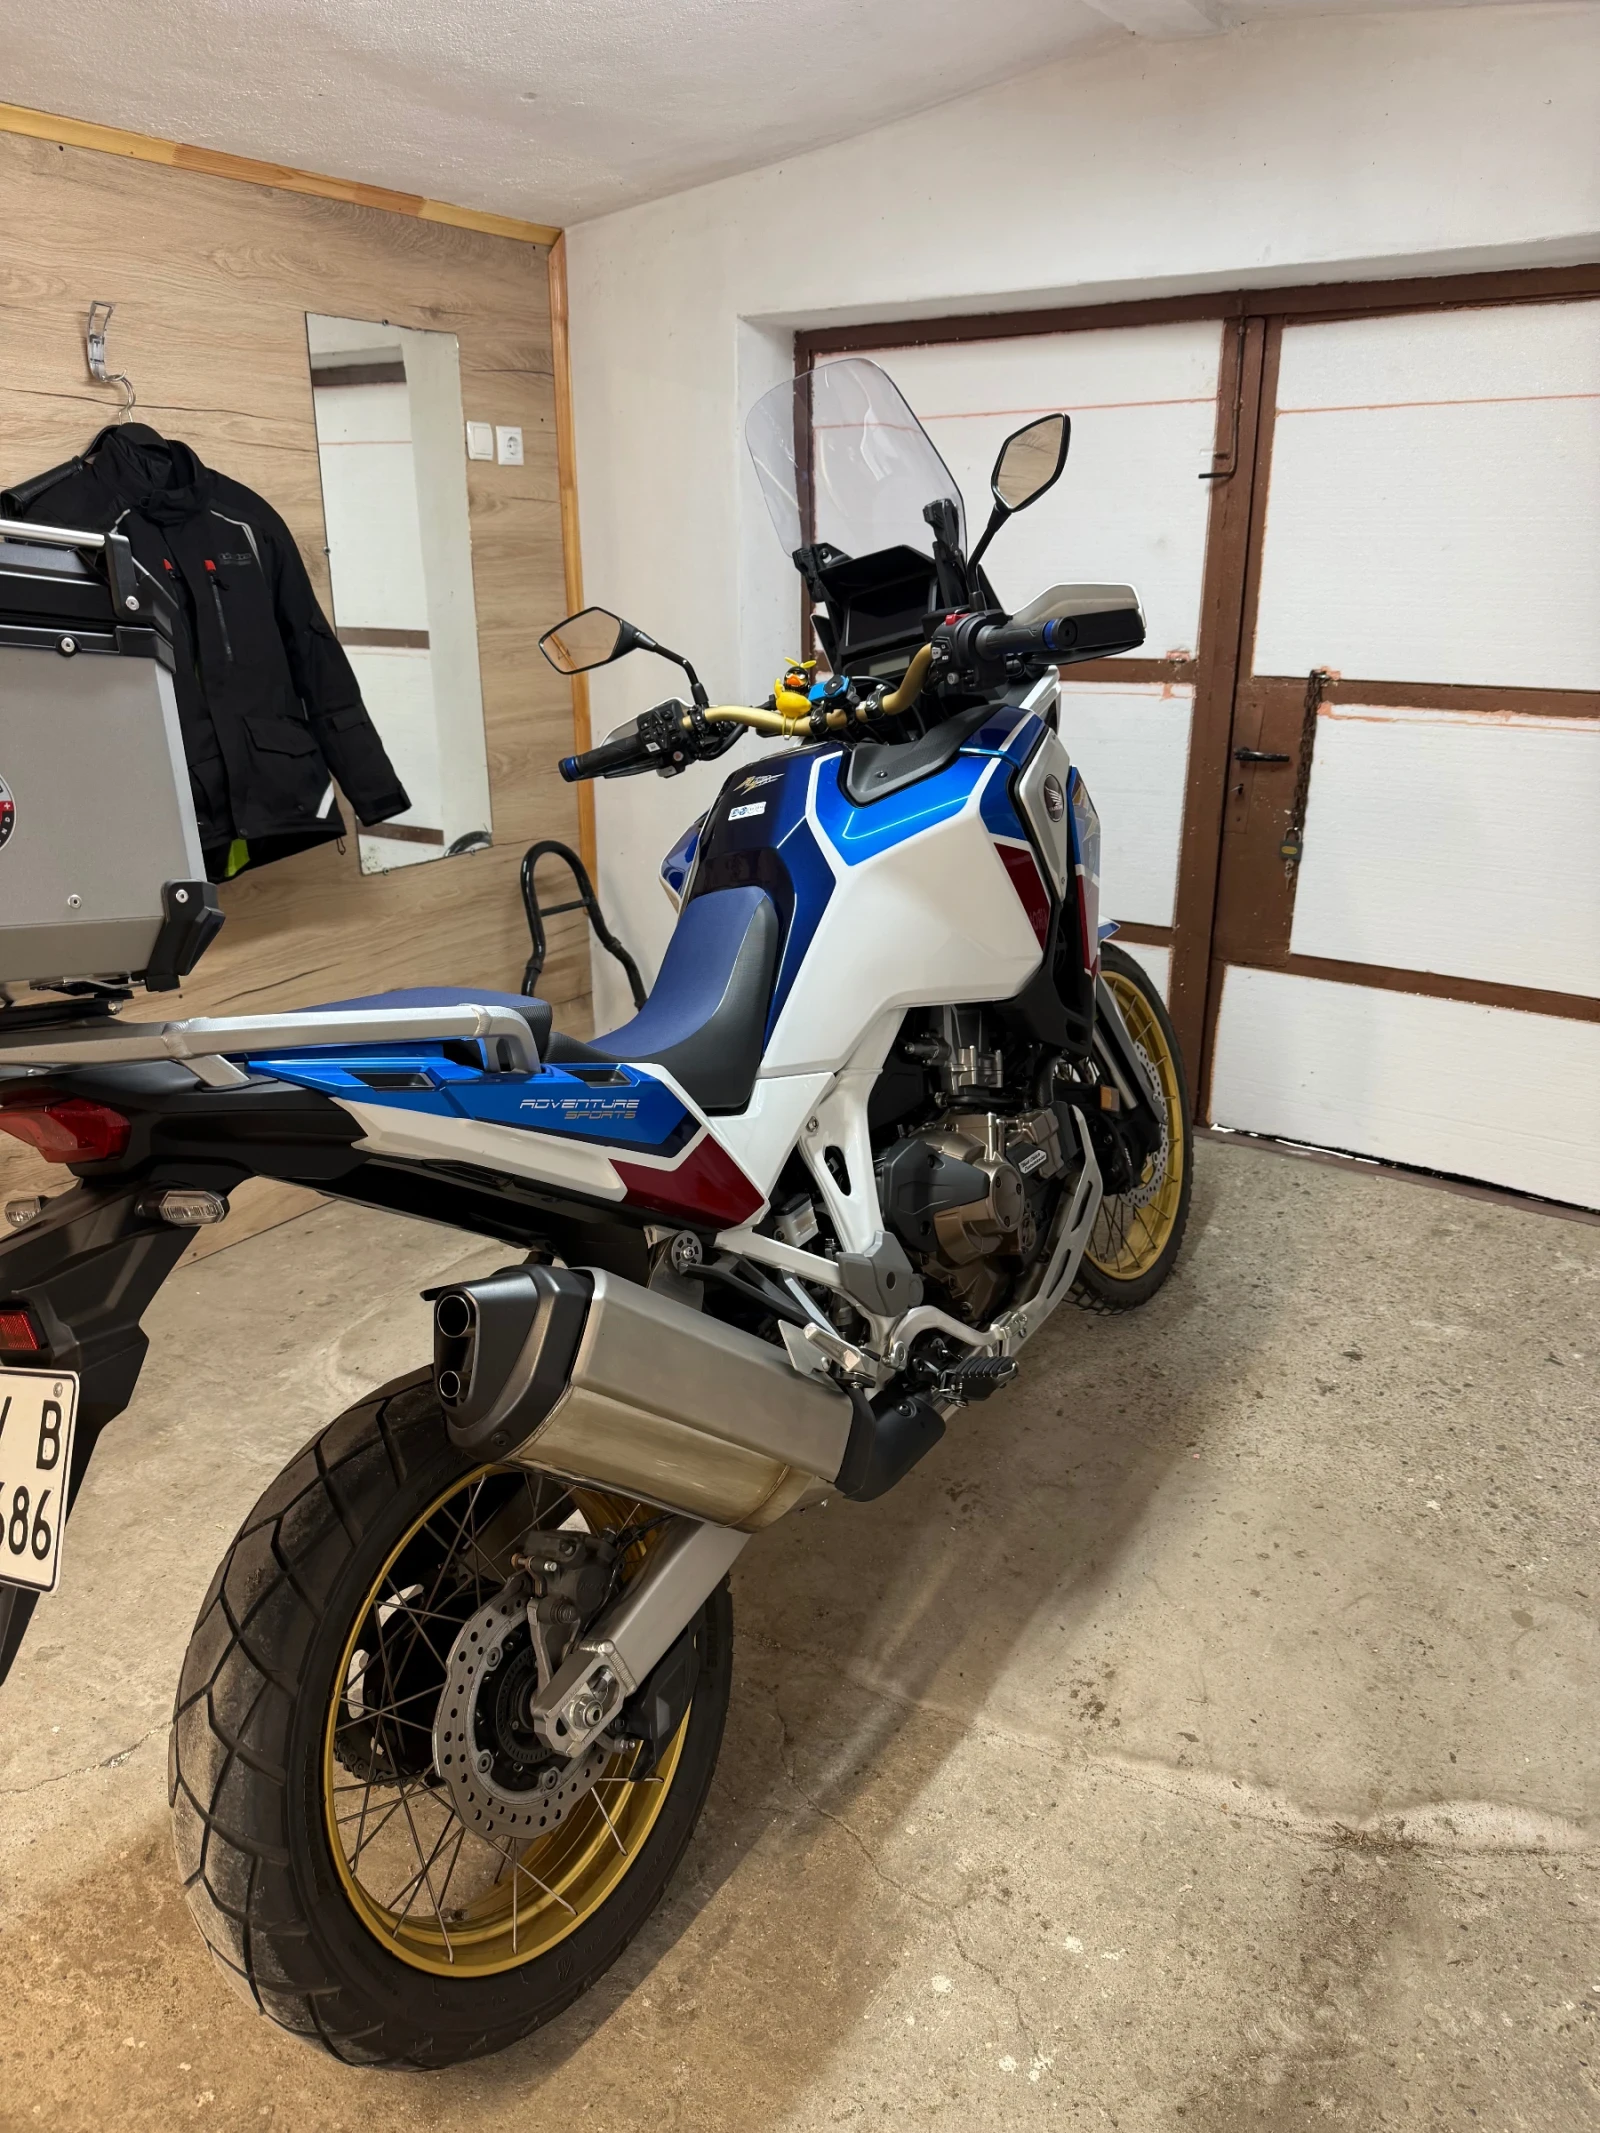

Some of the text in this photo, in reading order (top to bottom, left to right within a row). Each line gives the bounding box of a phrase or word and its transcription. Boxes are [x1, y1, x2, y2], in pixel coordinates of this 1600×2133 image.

[519, 1098, 640, 1109] ADVENTURE
[564, 1110, 637, 1120] SPORTS
[37, 1400, 62, 1470] B
[0, 1482, 51, 1560] 86
